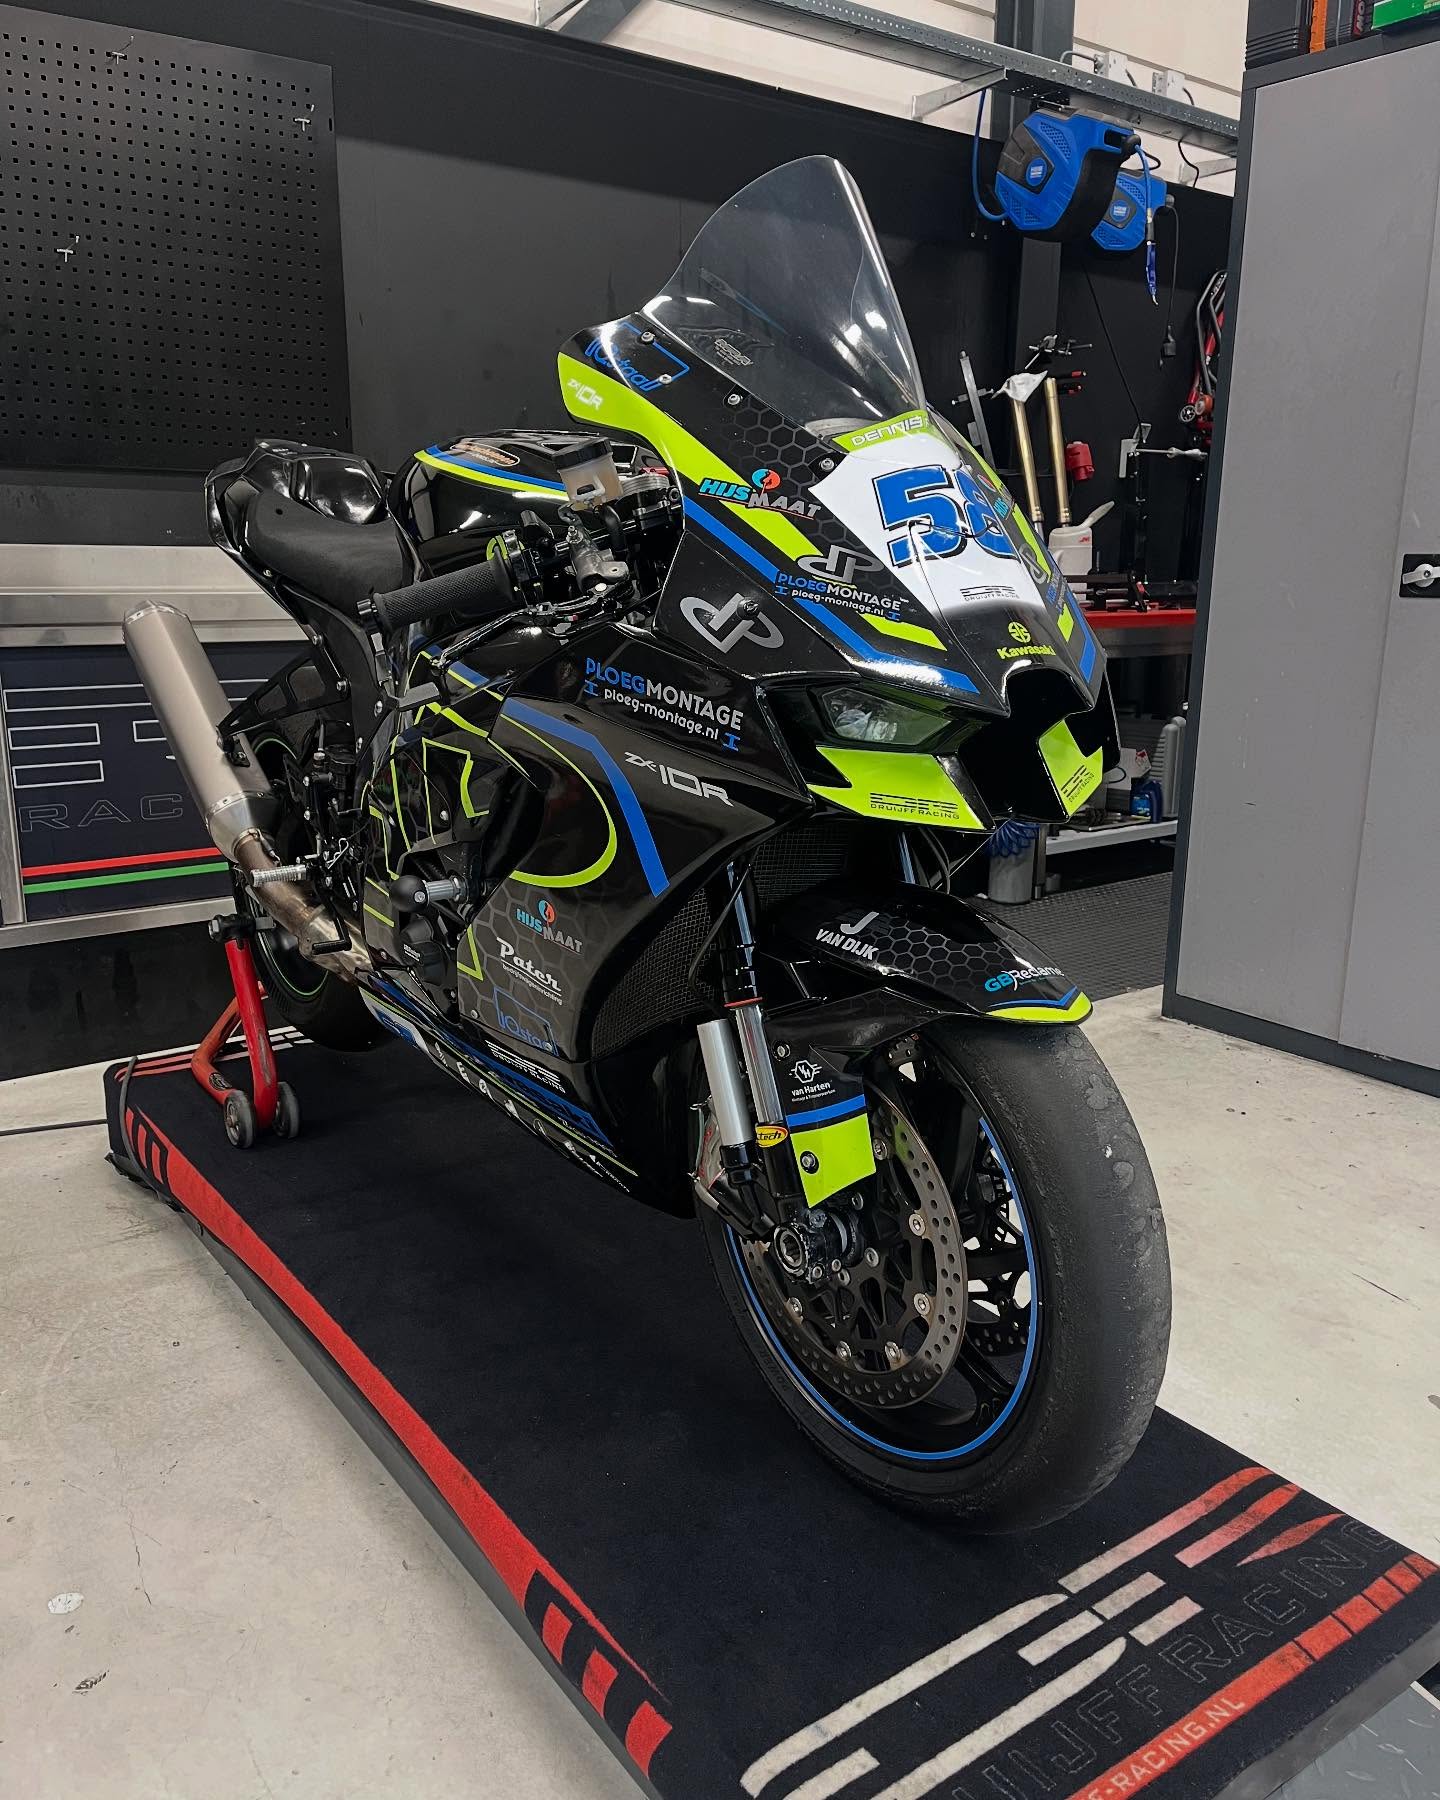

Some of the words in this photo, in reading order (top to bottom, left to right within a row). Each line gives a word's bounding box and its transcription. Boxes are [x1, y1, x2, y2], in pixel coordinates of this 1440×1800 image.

[851, 415, 923, 446] DENNIS
[699, 479, 752, 501] HIJS
[748, 492, 822, 517] MAAT
[777, 572, 902, 611] PLOEGMONTAGE
[791, 588, 884, 616] ploeg-montage.nl
[996, 644, 1057, 660] Kawasaki
[586, 657, 744, 731] PLOEGMONTAGE
[604, 688, 719, 741] ploeg-montage.nl
[869, 803, 917, 815] DRUIJFF
[918, 809, 960, 820] RACING
[516, 908, 544, 934] HIJS
[543, 926, 583, 954] MAAT
[816, 928, 846, 947] VAN
[841, 938, 879, 961] DIJK
[803, 1081, 831, 1094] Harten
[756, 1130, 782, 1141] tech
